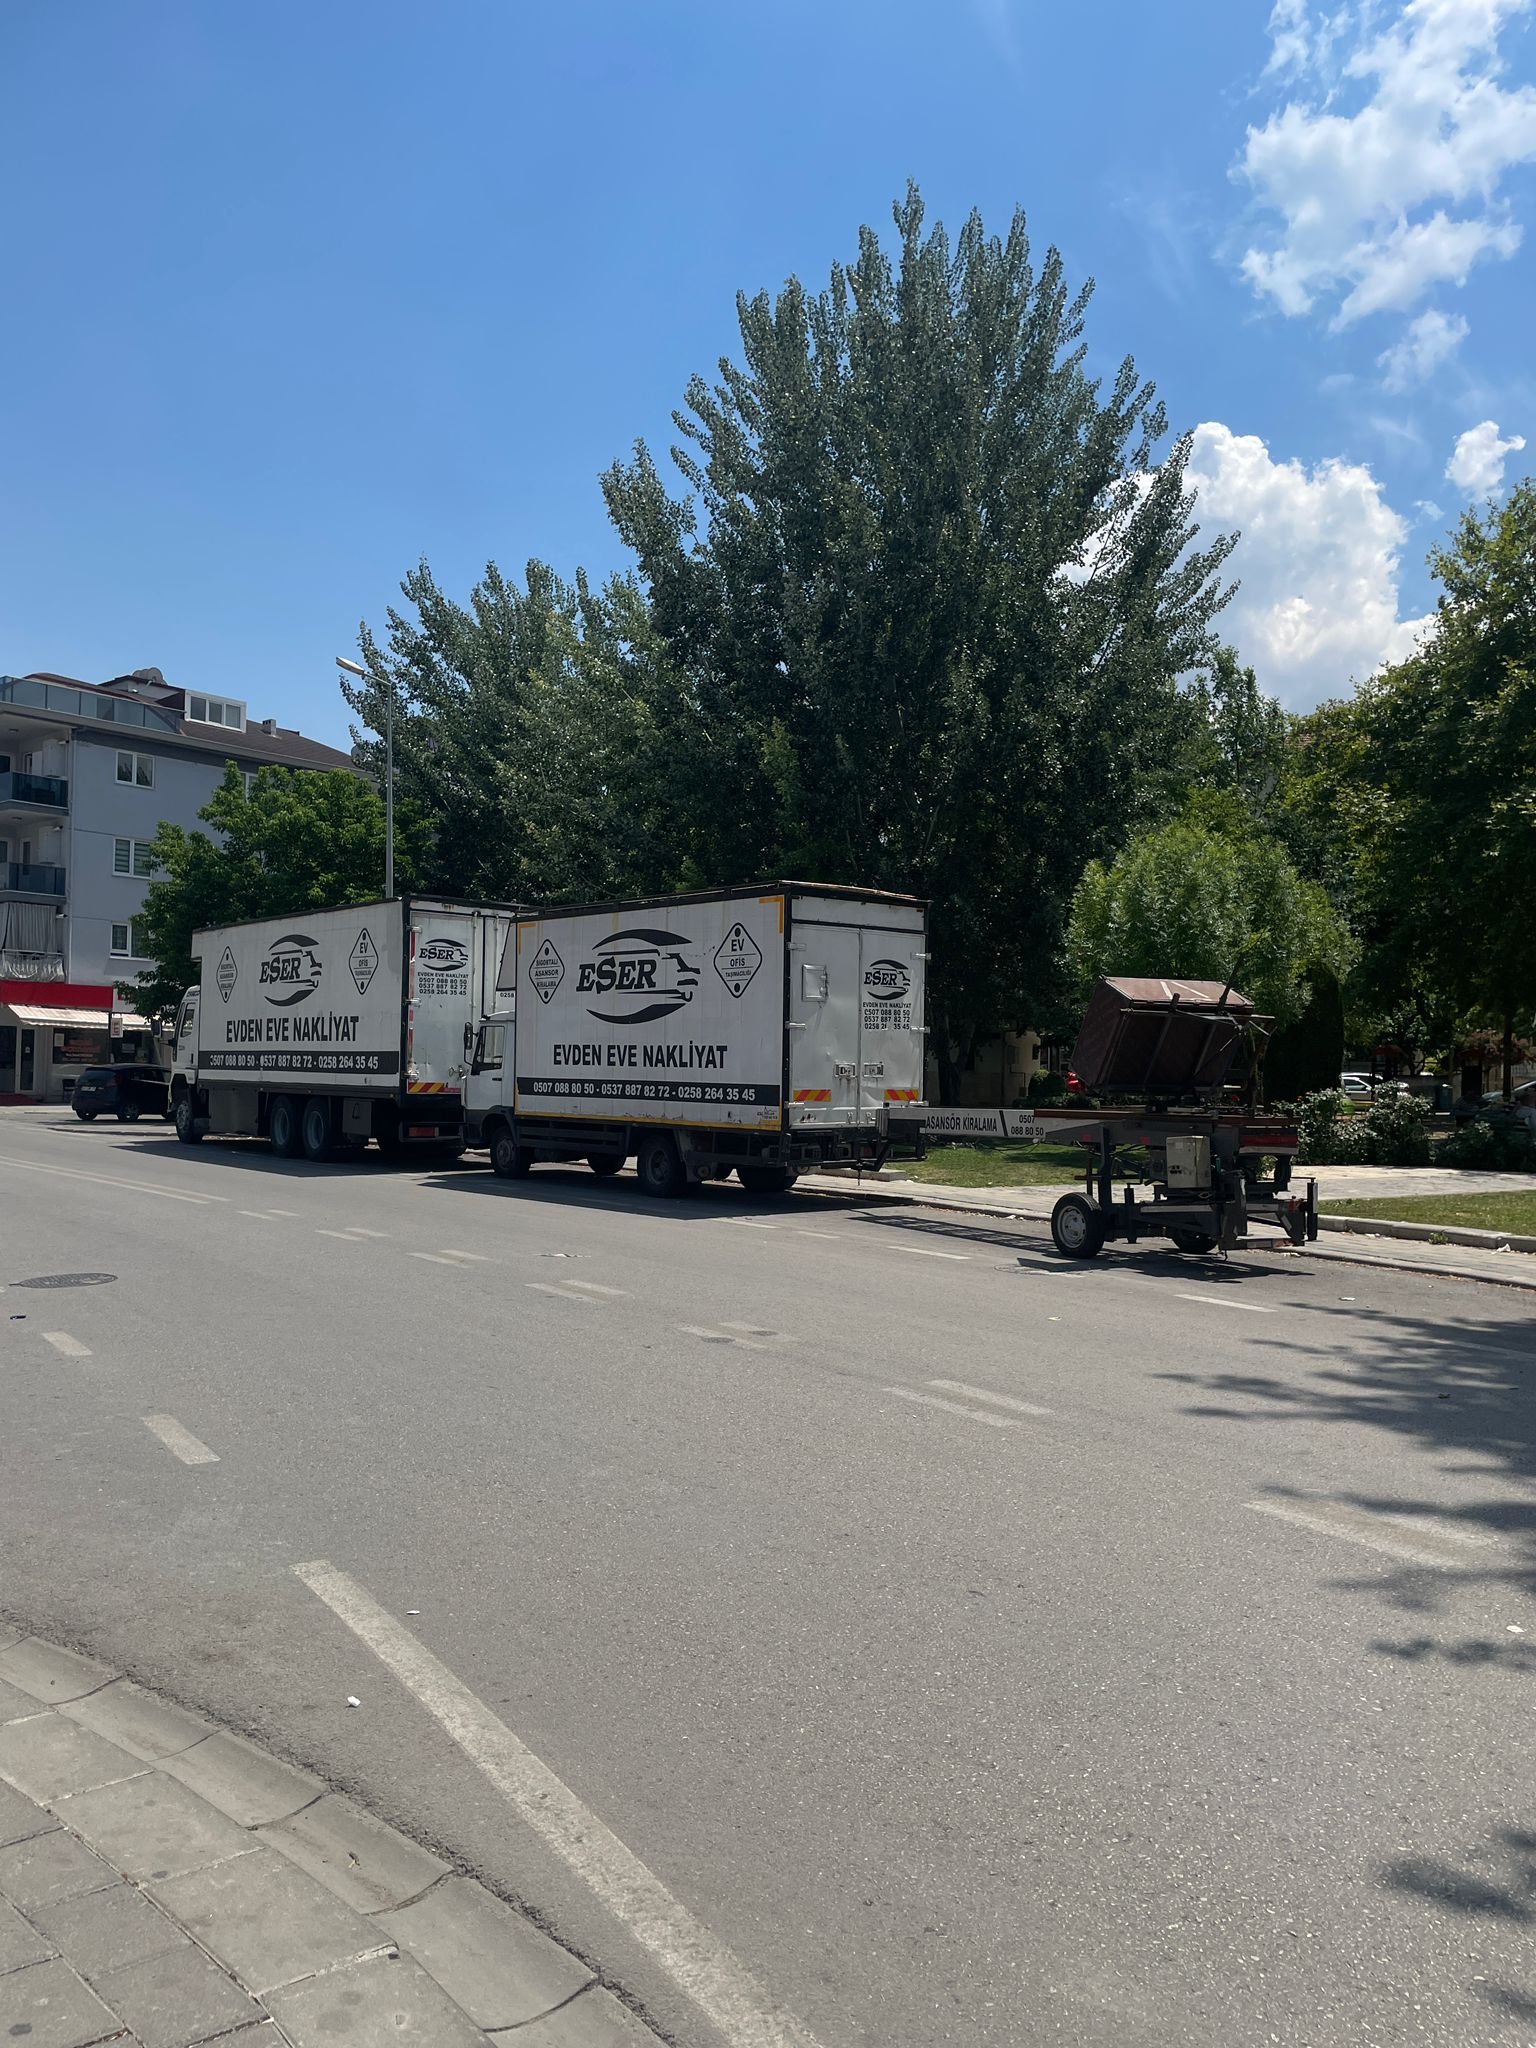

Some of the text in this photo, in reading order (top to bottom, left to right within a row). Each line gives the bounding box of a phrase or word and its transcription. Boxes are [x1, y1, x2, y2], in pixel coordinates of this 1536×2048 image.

[360, 942, 368, 954] EV
[731, 938, 744, 952] EV
[419, 948, 454, 960] ESER
[259, 956, 302, 984] ESER
[576, 956, 656, 994] ESER
[864, 971, 898, 986] ESER
[226, 1011, 359, 1042] EVDEN EVE NAKLİYAT
[238, 1054, 246, 1066] 80
[247, 1054, 255, 1066] 50
[278, 1055, 290, 1068] 887
[292, 1056, 300, 1068] 82
[303, 1056, 312, 1068] 72
[318, 1056, 336, 1068] 0258
[338, 1056, 354, 1069] 264
[356, 1056, 366, 1069] 35
[368, 1056, 378, 1070] 45
[553, 1040, 728, 1068] EVDEN EVE NAKLİYAT
[533, 1082, 552, 1093] 0507
[554, 1082, 570, 1094] 088
[571, 1082, 582, 1094] 80
[584, 1083, 594, 1094] 50
[602, 1084, 622, 1096] 0537
[625, 1084, 642, 1096] 887
[644, 1085, 656, 1097] 82
[658, 1086, 670, 1098] 72
[678, 1086, 702, 1099] 0258
[704, 1087, 724, 1100] 264
[726, 1088, 739, 1100] 35
[742, 1088, 755, 1100] 45
[926, 1112, 998, 1132] ASANSÖR KİRALAMA
[1019, 1114, 1035, 1124] 0507
[1010, 1126, 1044, 1136] 088 80 50
